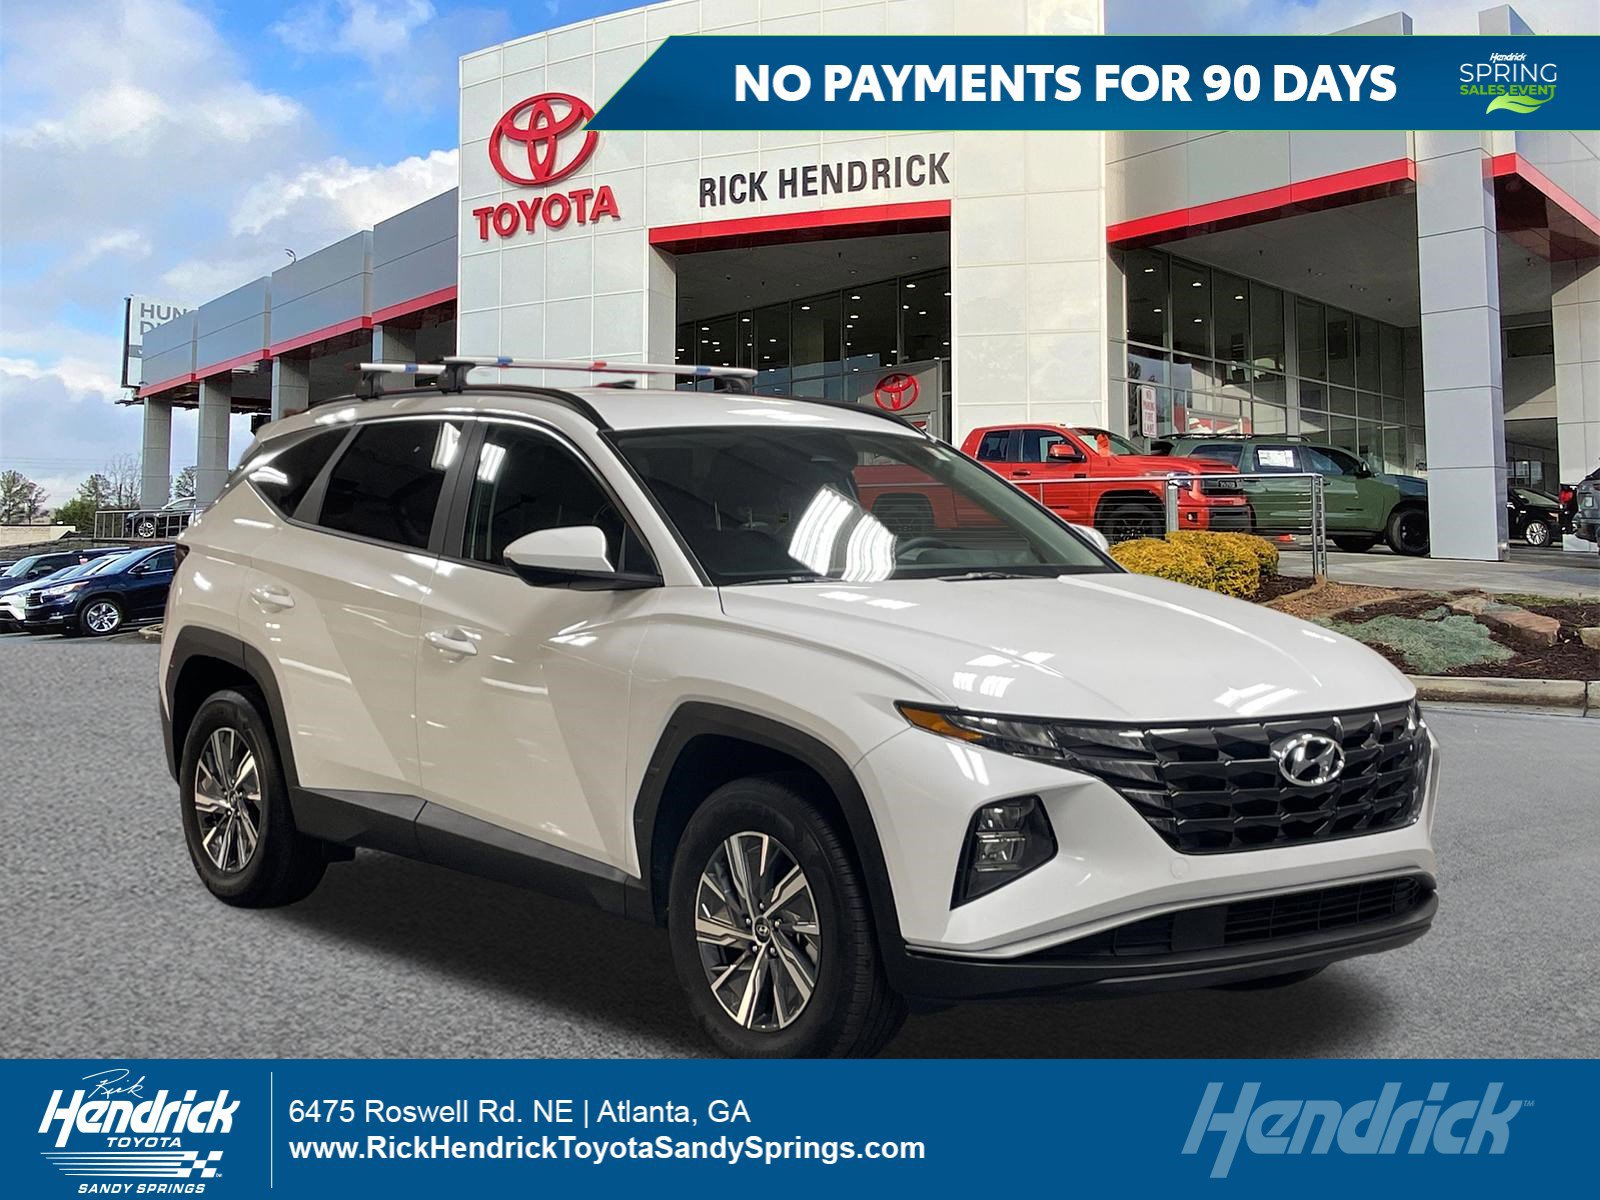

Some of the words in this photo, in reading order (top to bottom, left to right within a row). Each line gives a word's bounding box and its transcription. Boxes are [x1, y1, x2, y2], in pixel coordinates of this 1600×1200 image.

[699, 170, 769, 208] RICK
[778, 152, 952, 200] HENDRICK
[473, 185, 621, 240] TOYOTA
